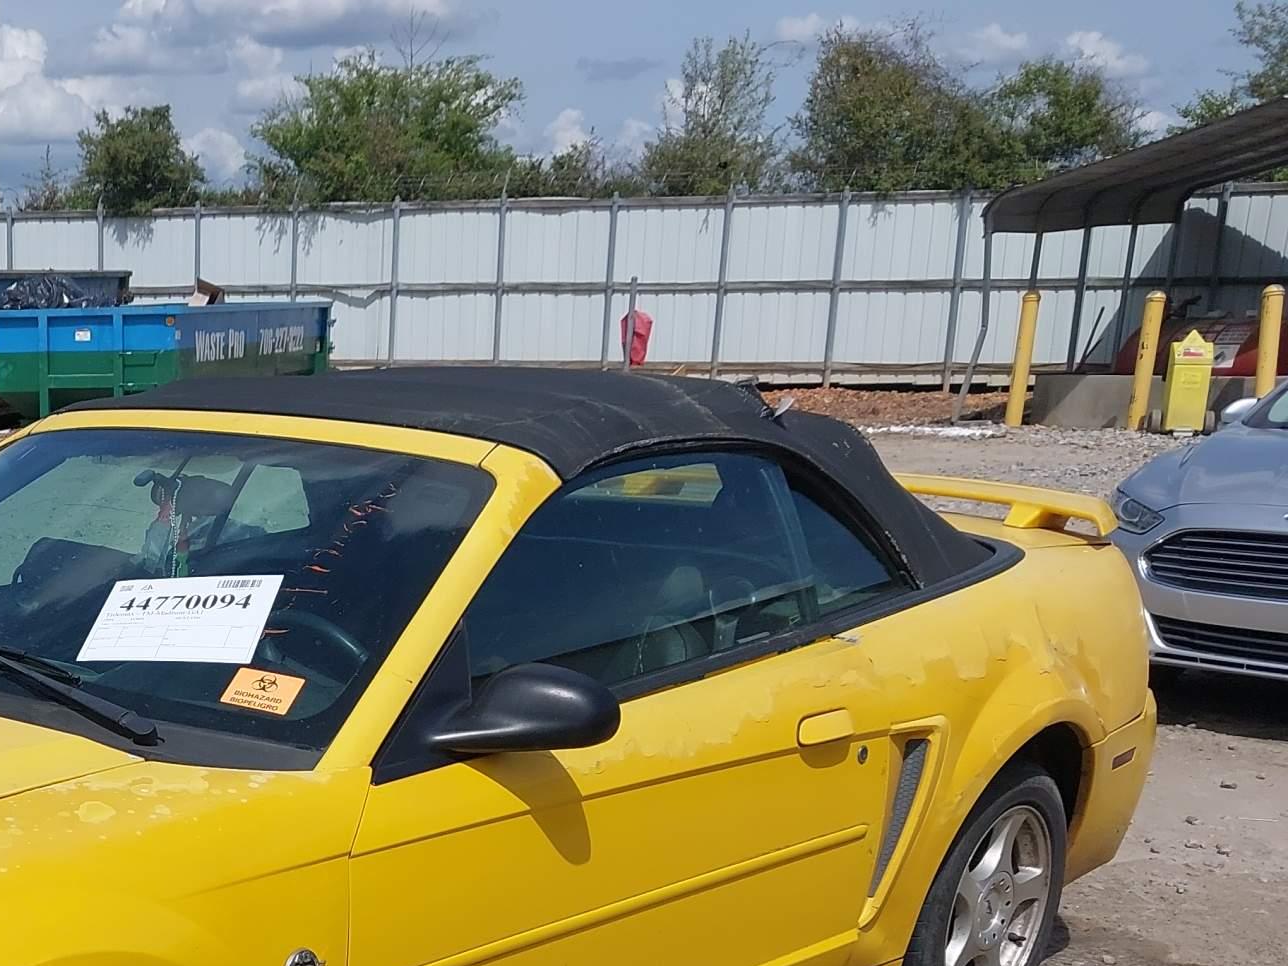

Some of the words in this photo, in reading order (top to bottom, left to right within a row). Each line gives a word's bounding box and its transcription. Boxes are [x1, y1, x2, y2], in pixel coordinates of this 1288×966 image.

[195, 329, 225, 362] WASTE
[119, 594, 252, 611] 44770094
[230, 696, 279, 711] BIOPELIGRO
[233, 689, 282, 704] BIOHAZARD
